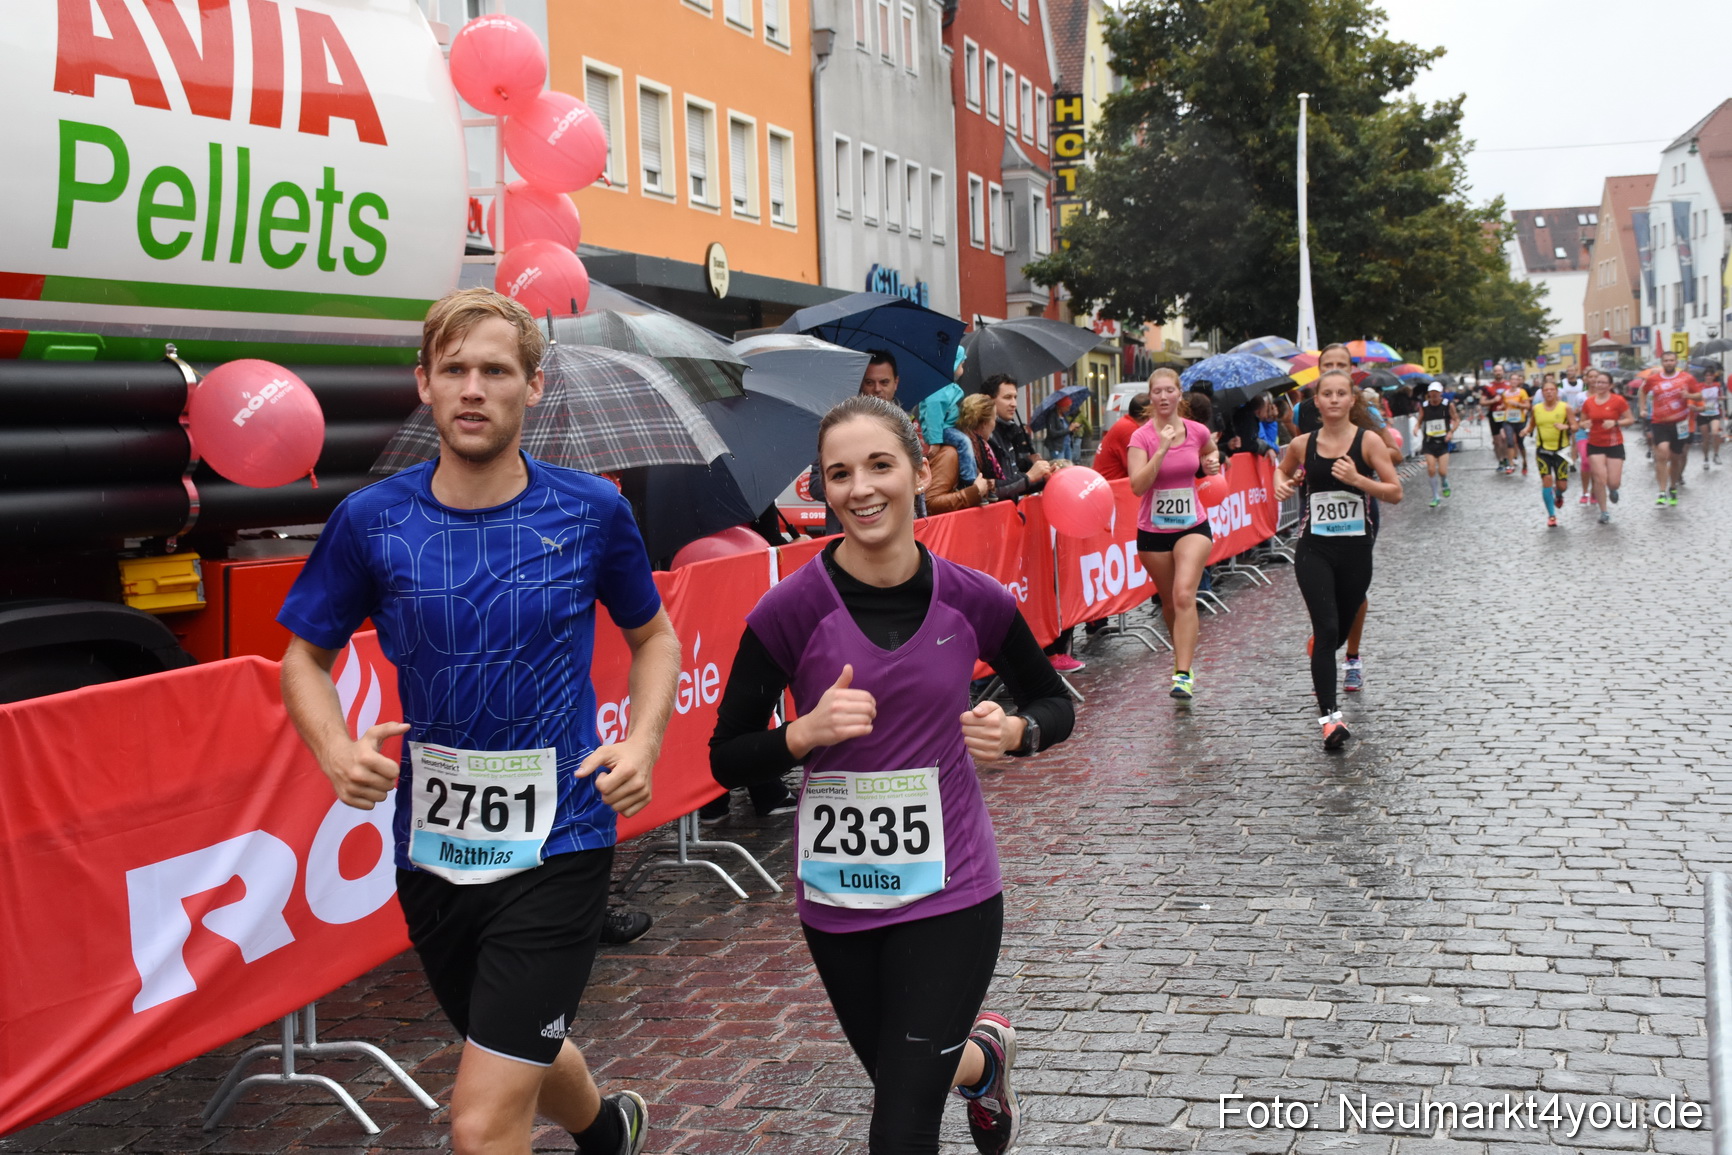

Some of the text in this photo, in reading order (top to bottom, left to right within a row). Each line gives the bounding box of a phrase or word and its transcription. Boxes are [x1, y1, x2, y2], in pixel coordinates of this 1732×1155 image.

[53, 0, 388, 147] AVIA
[51, 118, 390, 277] Pellets
[508, 264, 540, 301] ÖDL
[1674, 341, 1686, 354] D
[1428, 356, 1438, 369] D
[232, 378, 290, 428] RÖDL
[1156, 498, 1191, 515] 2201
[1316, 501, 1359, 522] 2807
[467, 754, 542, 773] BOCK
[806, 786, 849, 796] NeuerMarkt
[855, 774, 928, 794] BOCK
[426, 777, 536, 833] 2761
[417, 819, 423, 829] D
[813, 804, 930, 857] 2335
[439, 841, 514, 866] Matthias
[839, 869, 901, 890] Louisa
